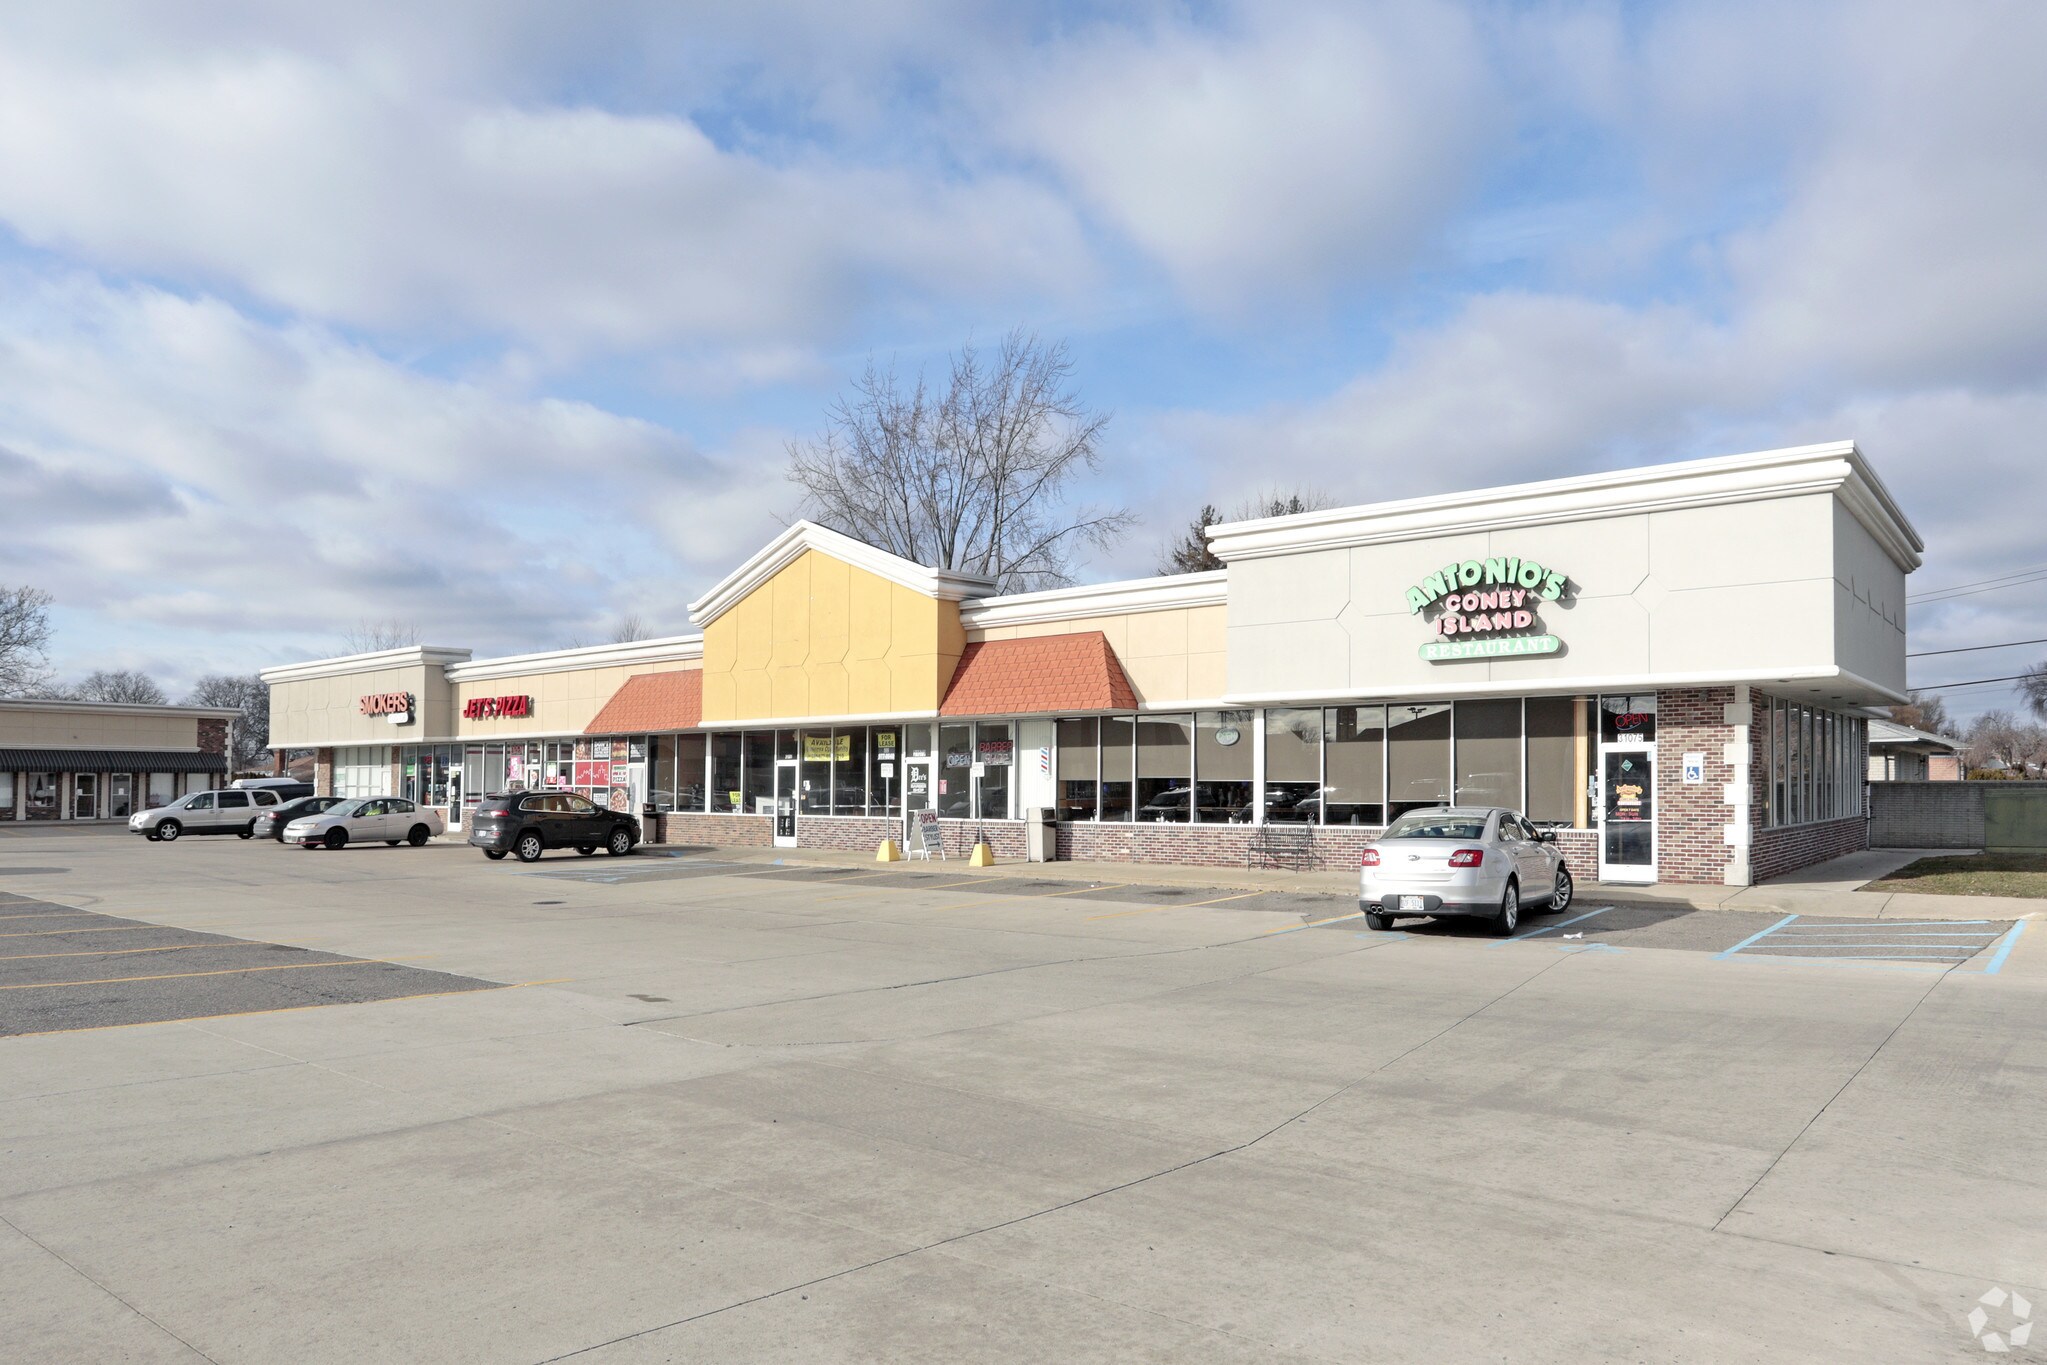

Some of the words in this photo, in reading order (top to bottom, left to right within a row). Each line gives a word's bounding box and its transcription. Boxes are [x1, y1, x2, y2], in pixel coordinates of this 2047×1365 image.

[1405, 557, 1567, 615] ANTONIO'S
[1446, 589, 1527, 612] CONEY
[1436, 610, 1533, 635] ISLAND
[1426, 638, 1552, 659] RESTAURANT
[360, 692, 408, 715] SMOKERS
[463, 697, 493, 718] JET'S
[494, 695, 529, 716] PIZZA
[1615, 713, 1648, 727] OPEN
[810, 738, 843, 746] AVAILLE
[1618, 734, 1644, 742] 31075
[948, 754, 971, 766] OPEN
[920, 813, 937, 823] OPEN
